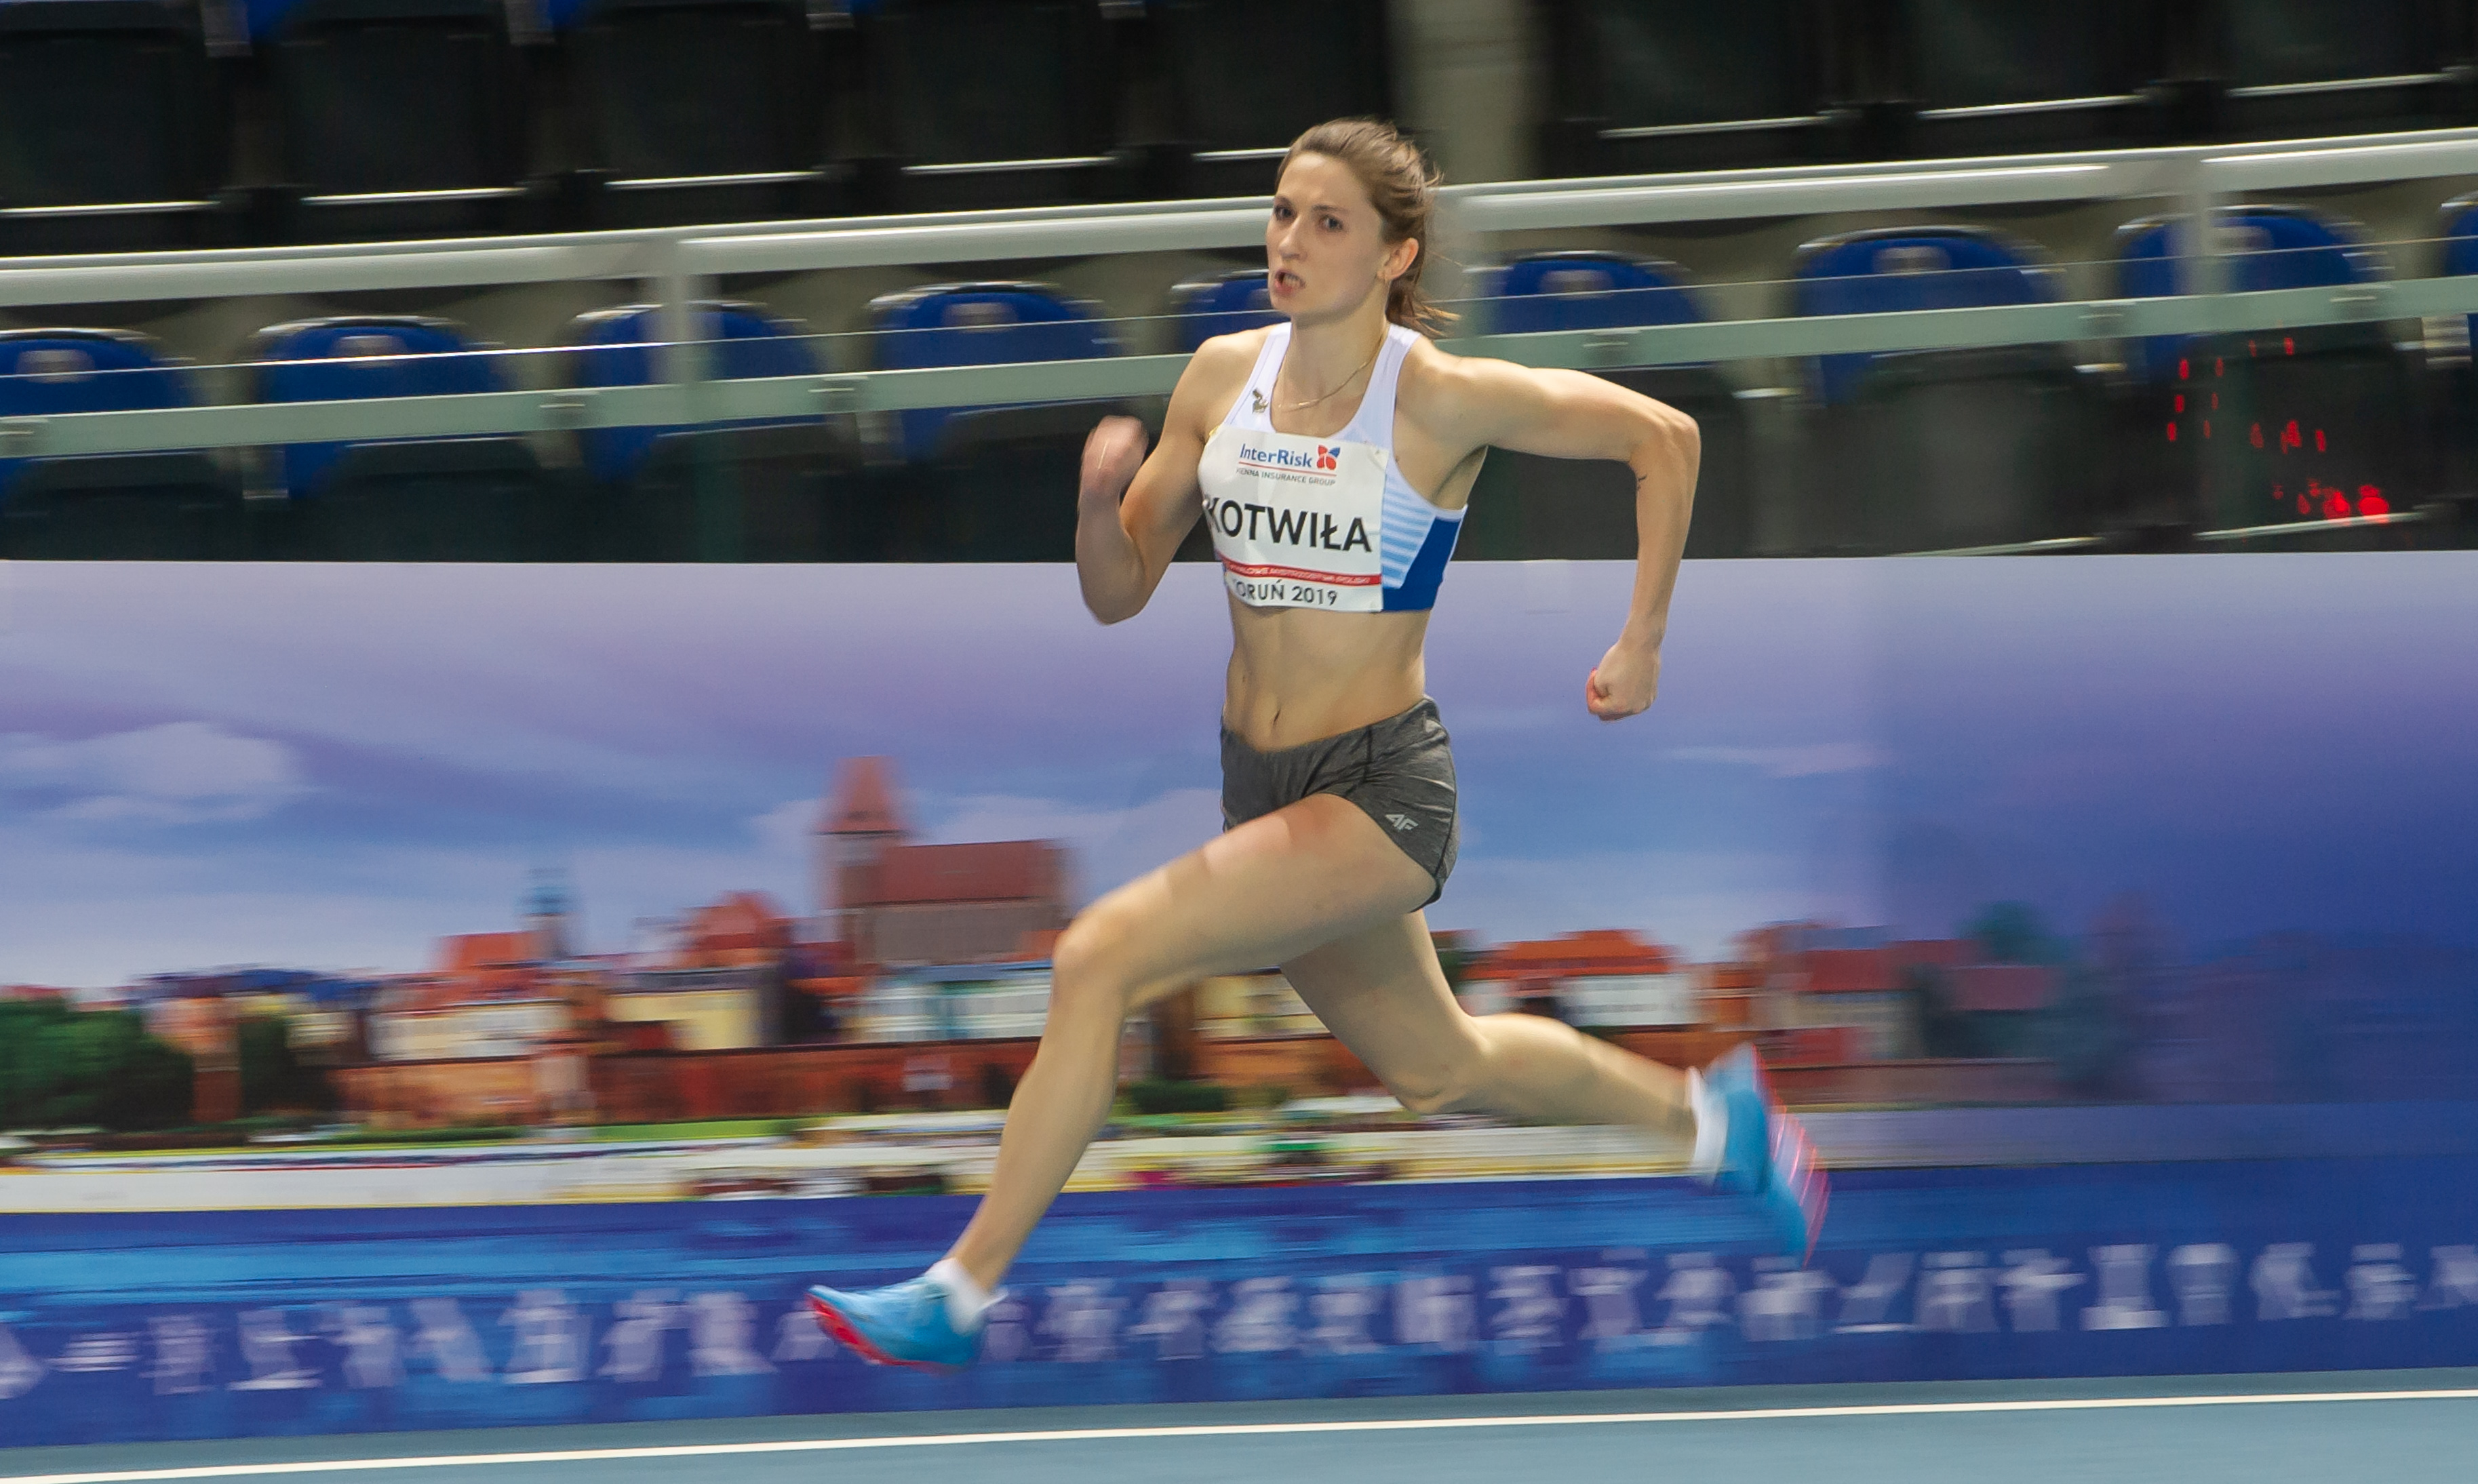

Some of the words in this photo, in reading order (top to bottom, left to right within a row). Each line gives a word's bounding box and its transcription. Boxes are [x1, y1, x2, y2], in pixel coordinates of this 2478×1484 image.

[1240, 443, 1312, 468] InterRisk
[1261, 471, 1306, 483] INSURANCE
[1308, 477, 1335, 486] GROUP
[1291, 586, 1337, 605] 2019
